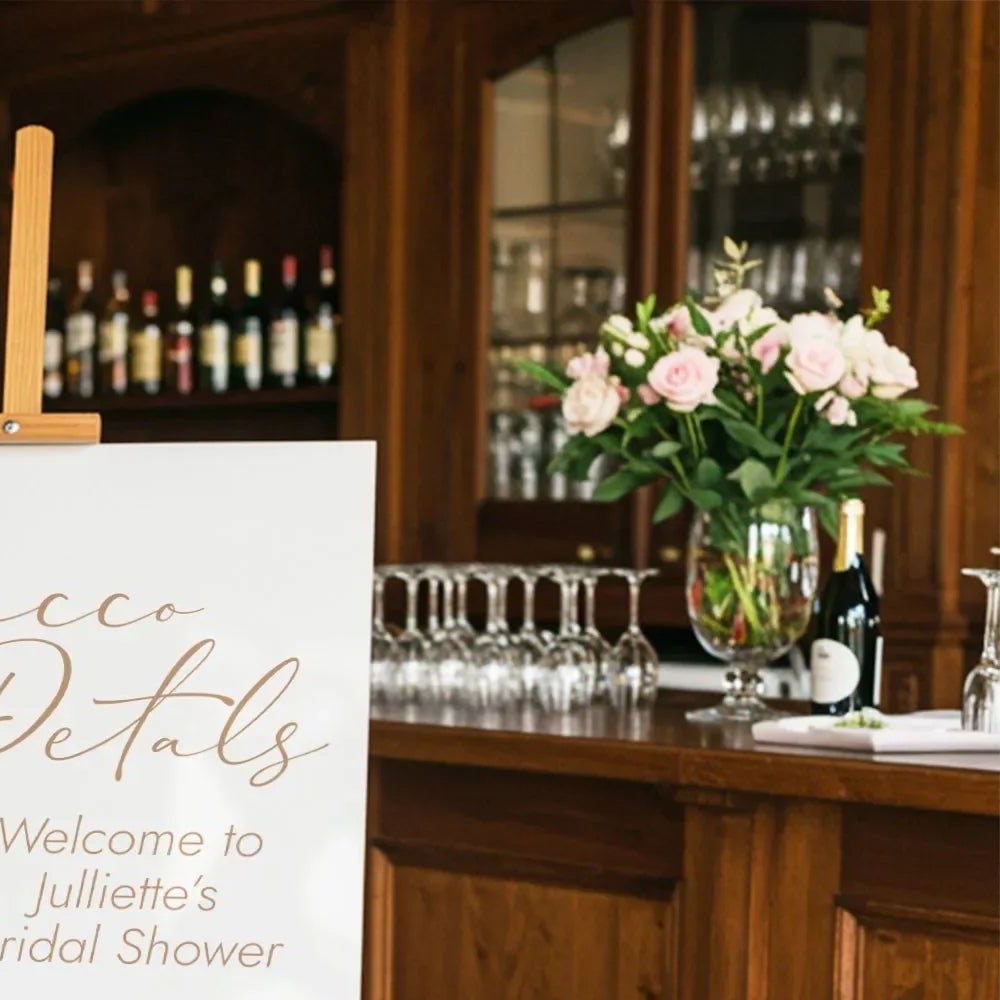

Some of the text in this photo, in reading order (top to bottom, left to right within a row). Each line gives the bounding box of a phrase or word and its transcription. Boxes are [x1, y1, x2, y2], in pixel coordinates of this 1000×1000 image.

[0, 814, 264, 858] Welcome to
[23, 868, 218, 919] Julliette's
[116, 924, 285, 968] Shower
